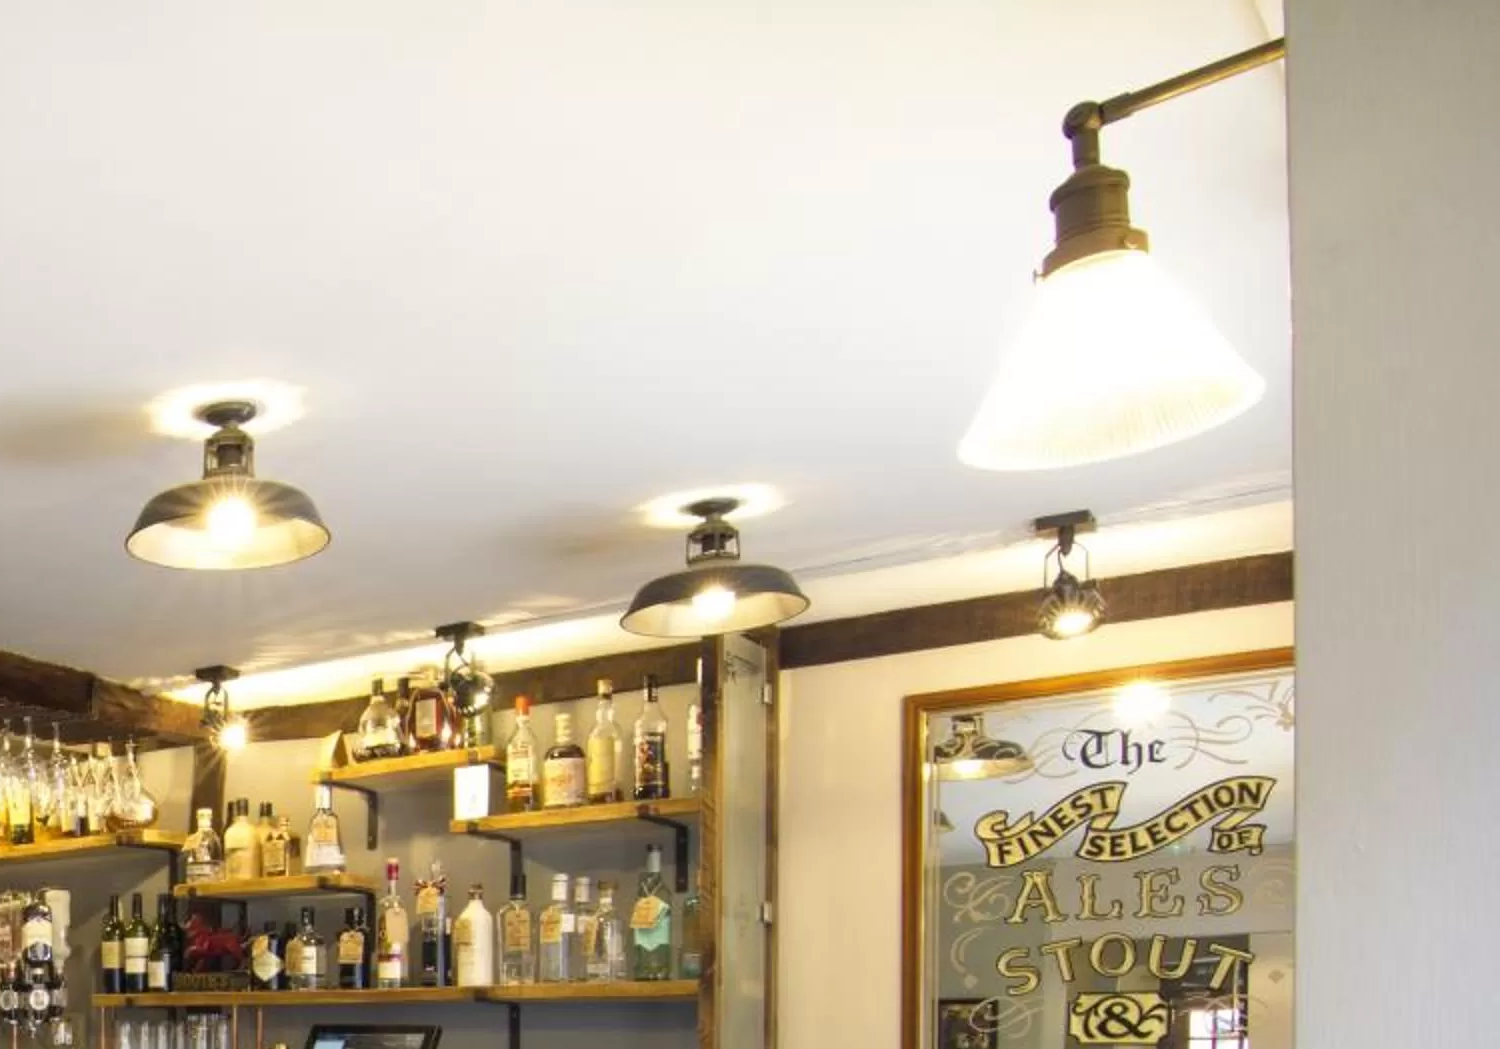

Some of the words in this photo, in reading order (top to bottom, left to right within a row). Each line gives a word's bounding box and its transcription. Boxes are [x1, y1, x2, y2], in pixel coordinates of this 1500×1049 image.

[1062, 729, 1168, 775] The
[998, 785, 1116, 865] FINEST
[1086, 781, 1264, 858] SELECTION
[1216, 832, 1252, 852] OF
[1005, 865, 1245, 925] ALES
[996, 932, 1255, 996] STOUT
